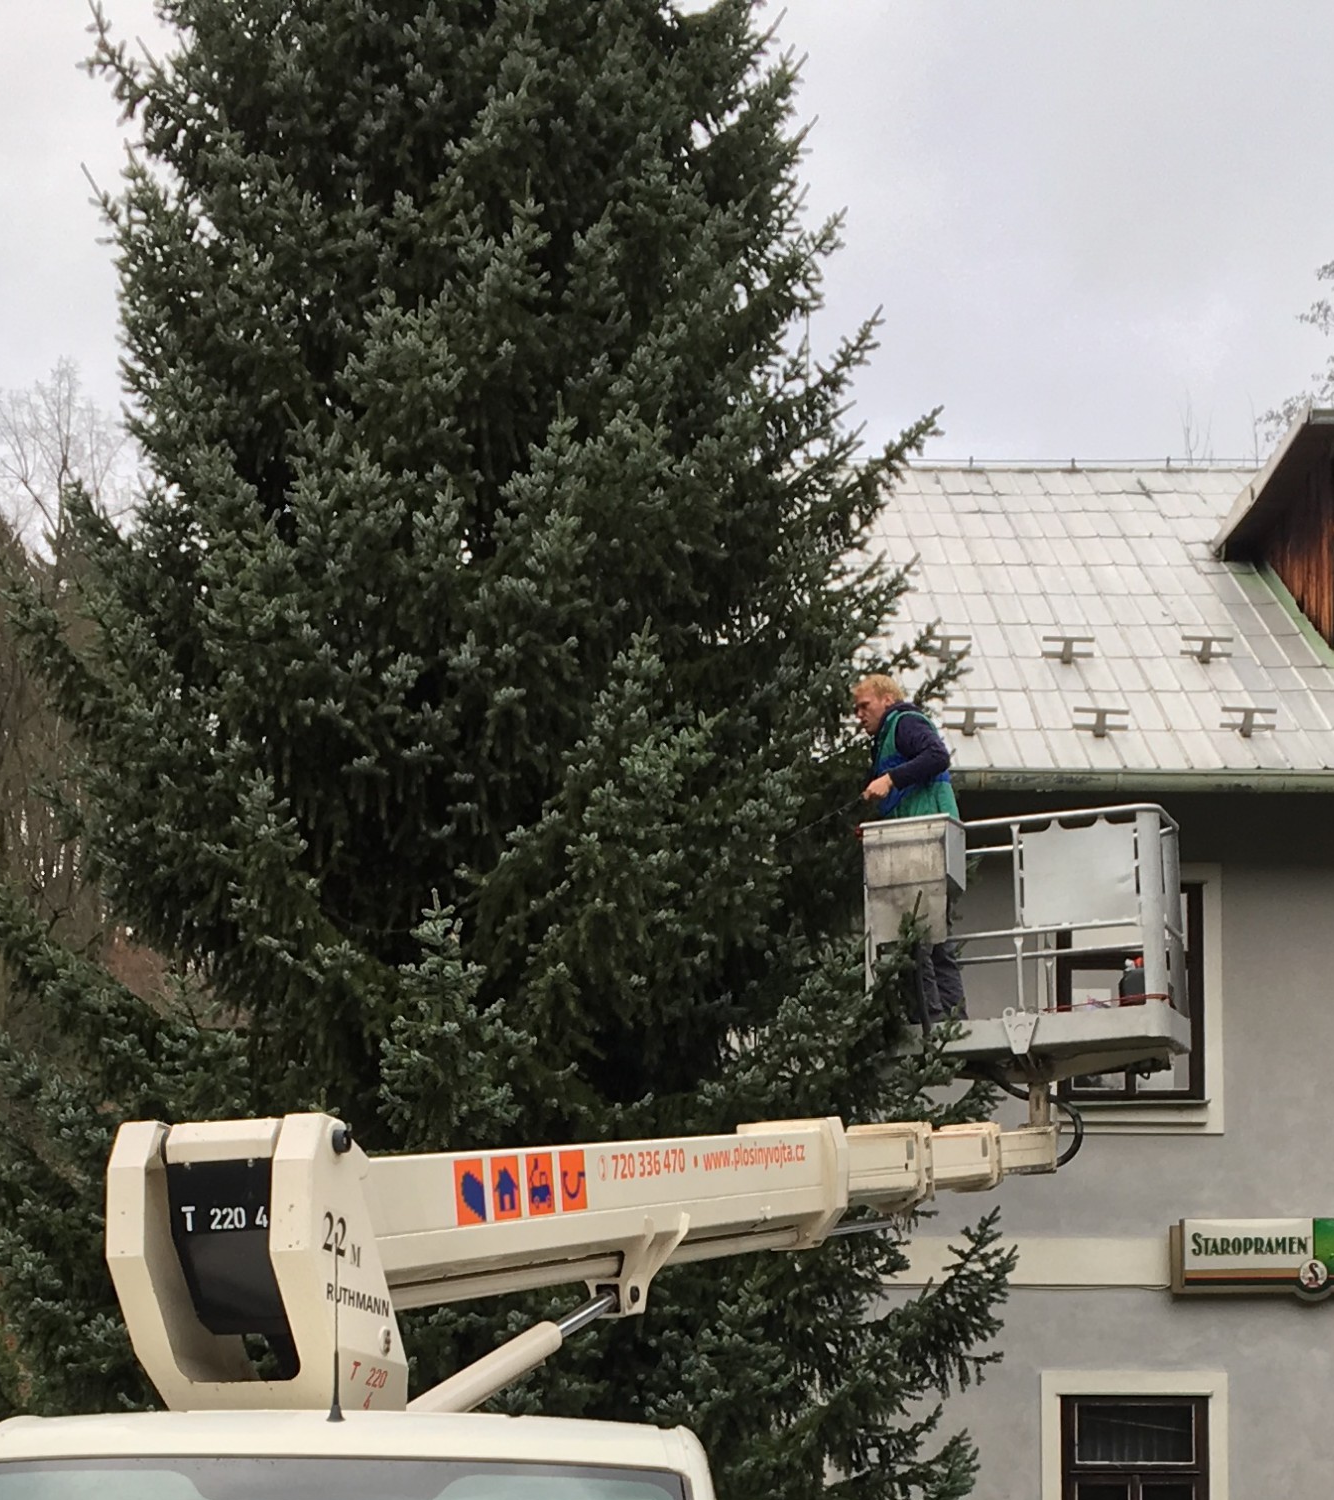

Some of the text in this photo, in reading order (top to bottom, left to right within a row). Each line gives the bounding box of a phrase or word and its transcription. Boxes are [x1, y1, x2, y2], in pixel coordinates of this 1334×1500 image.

[612, 1140, 806, 1180] 720 336 470 www.plosinyvojta.cz
[181, 1206, 268, 1232] T 220 4
[322, 1211, 347, 1257] 22
[1192, 1232, 1308, 1256] STAROPRAMEN
[326, 1282, 390, 1318] RUTHMANN
[350, 1361, 388, 1389] T 220
